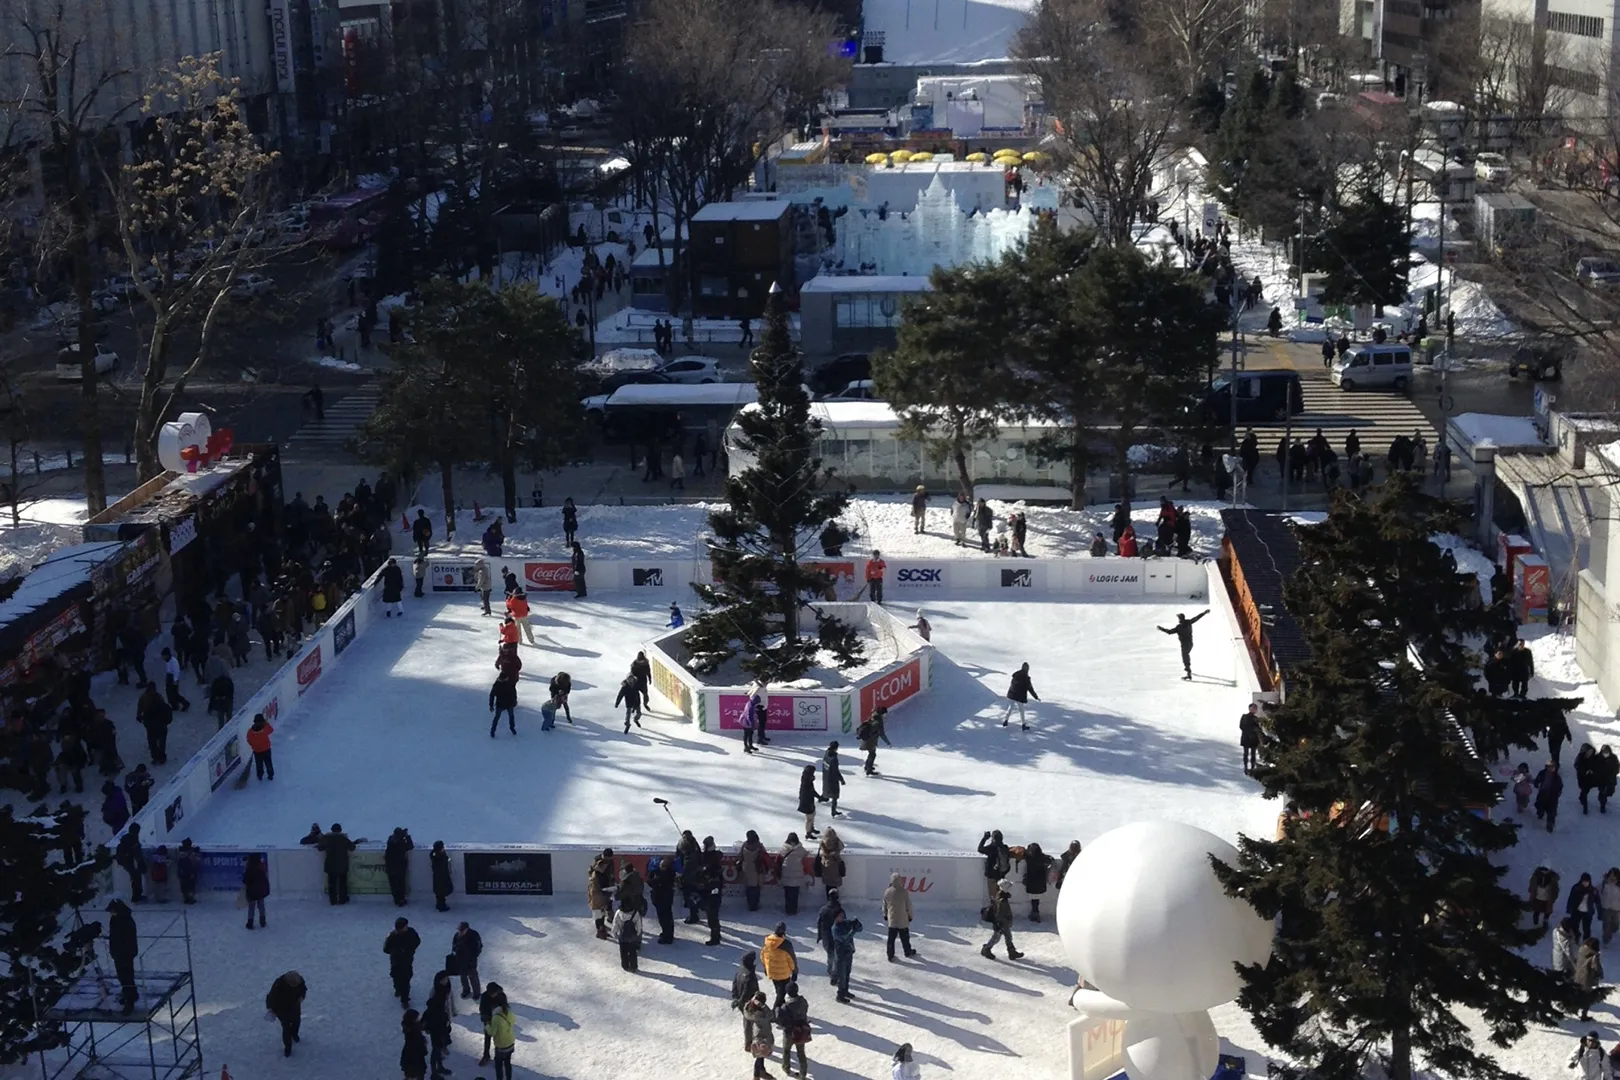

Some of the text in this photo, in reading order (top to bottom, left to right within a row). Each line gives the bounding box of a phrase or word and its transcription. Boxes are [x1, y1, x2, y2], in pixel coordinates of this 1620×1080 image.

[633, 568, 664, 586] MTV
[897, 568, 942, 581] SCSK
[1001, 569, 1032, 587] MTV
[1096, 575, 1138, 583] LOGIC JAM
[871, 669, 912, 713] J:COM
[723, 709, 791, 717] ショッンネル
